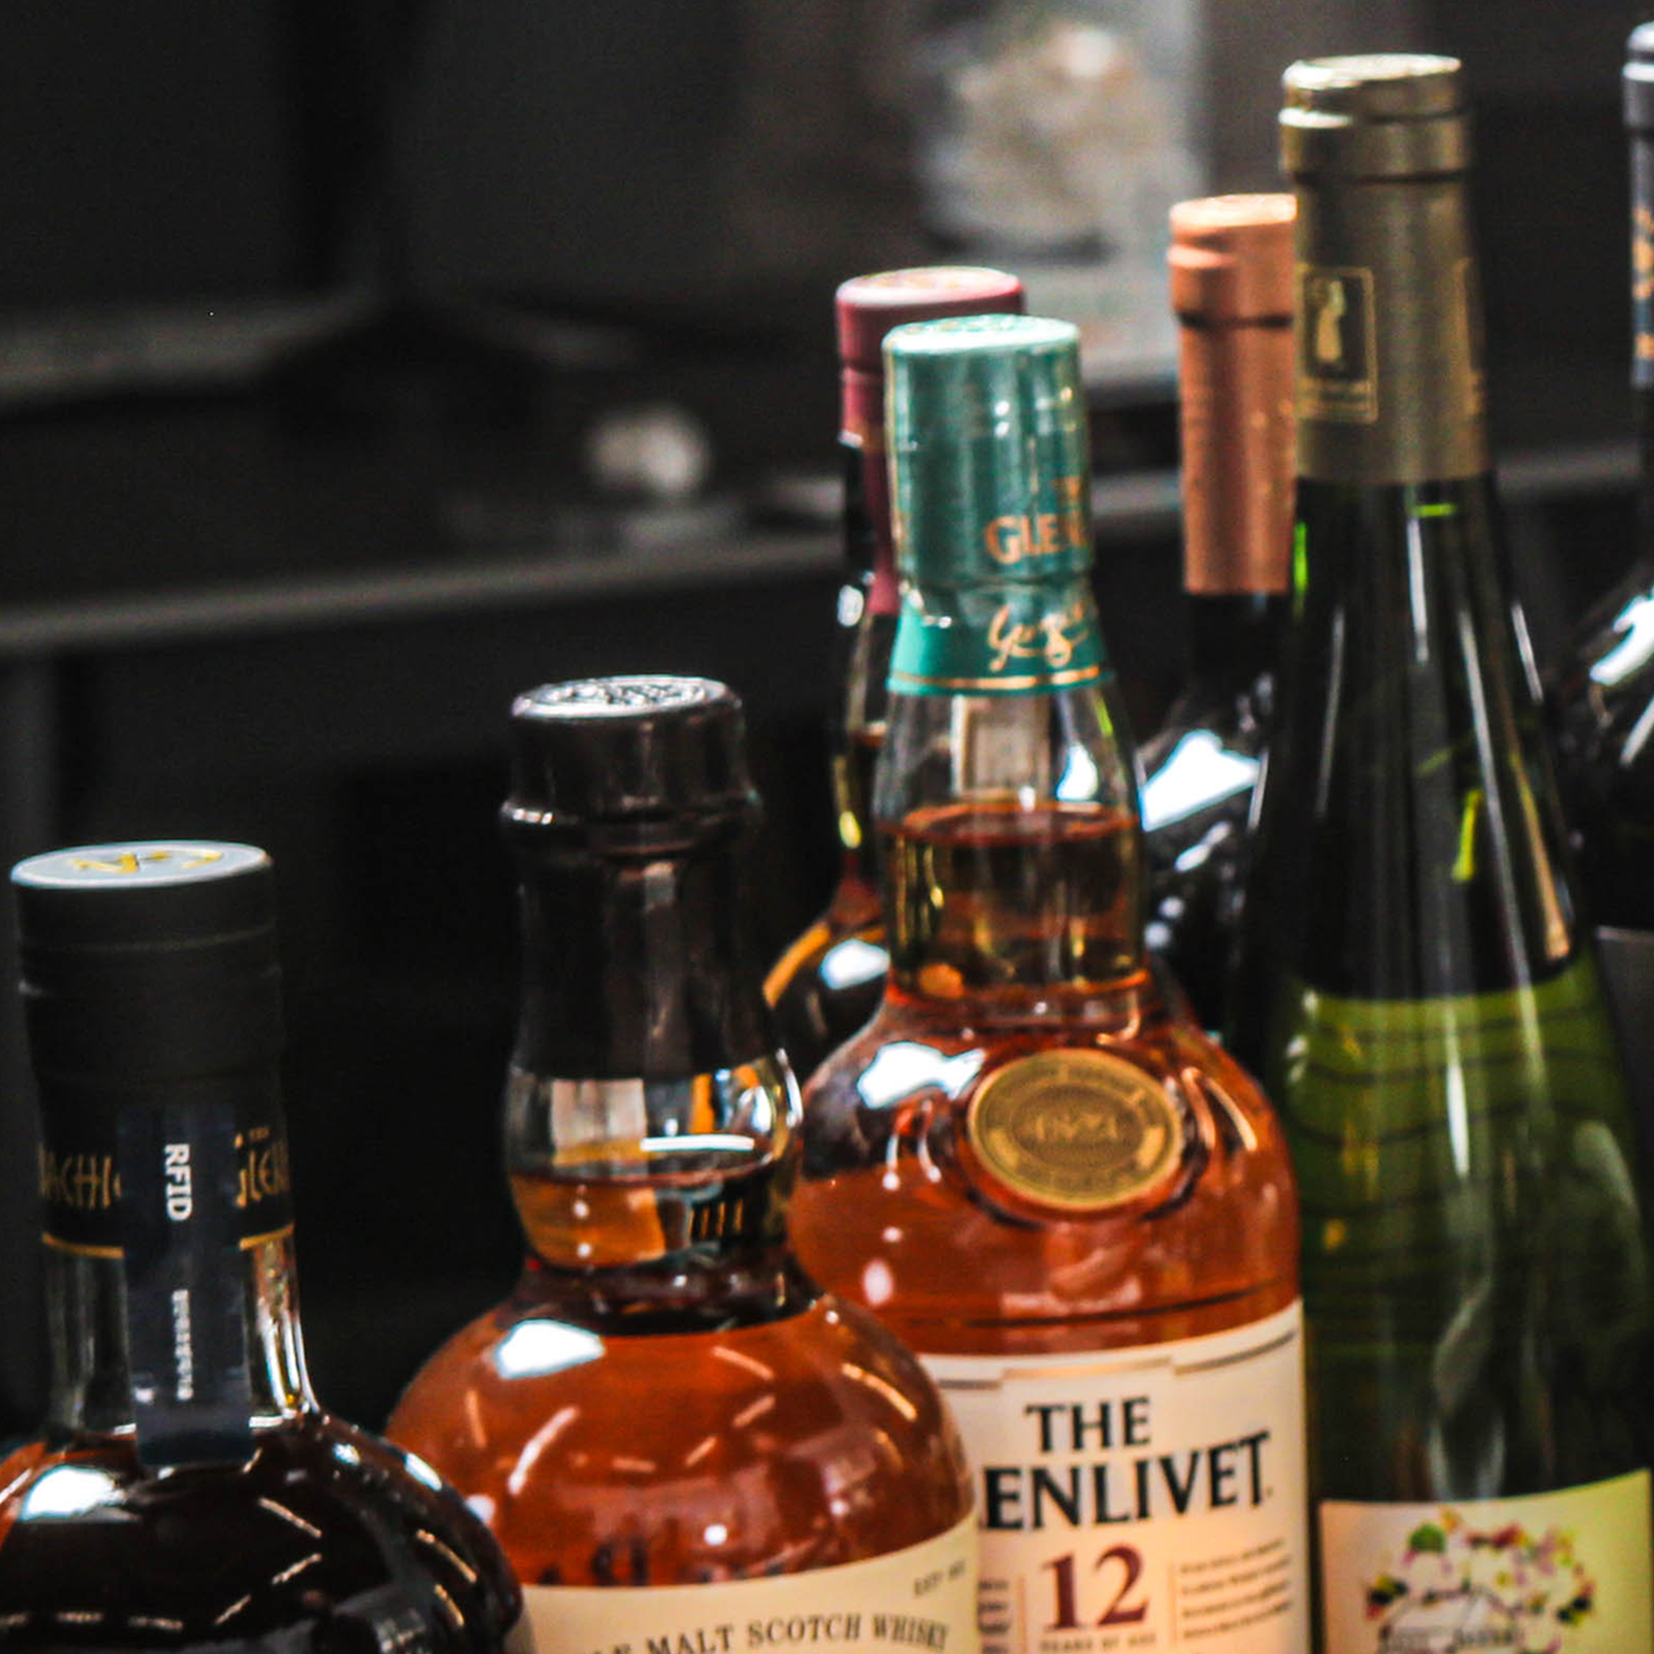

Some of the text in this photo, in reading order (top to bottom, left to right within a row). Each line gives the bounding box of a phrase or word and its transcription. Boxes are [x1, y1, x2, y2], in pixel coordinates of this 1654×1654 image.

[163, 1142, 193, 1222] RFID
[1024, 1396, 1151, 1454] THE
[981, 1431, 1271, 1532] ENLIVET
[1041, 1542, 1151, 1633] 12
[746, 1612, 863, 1648] SCOTCH
[871, 1612, 951, 1654] WHISKY
